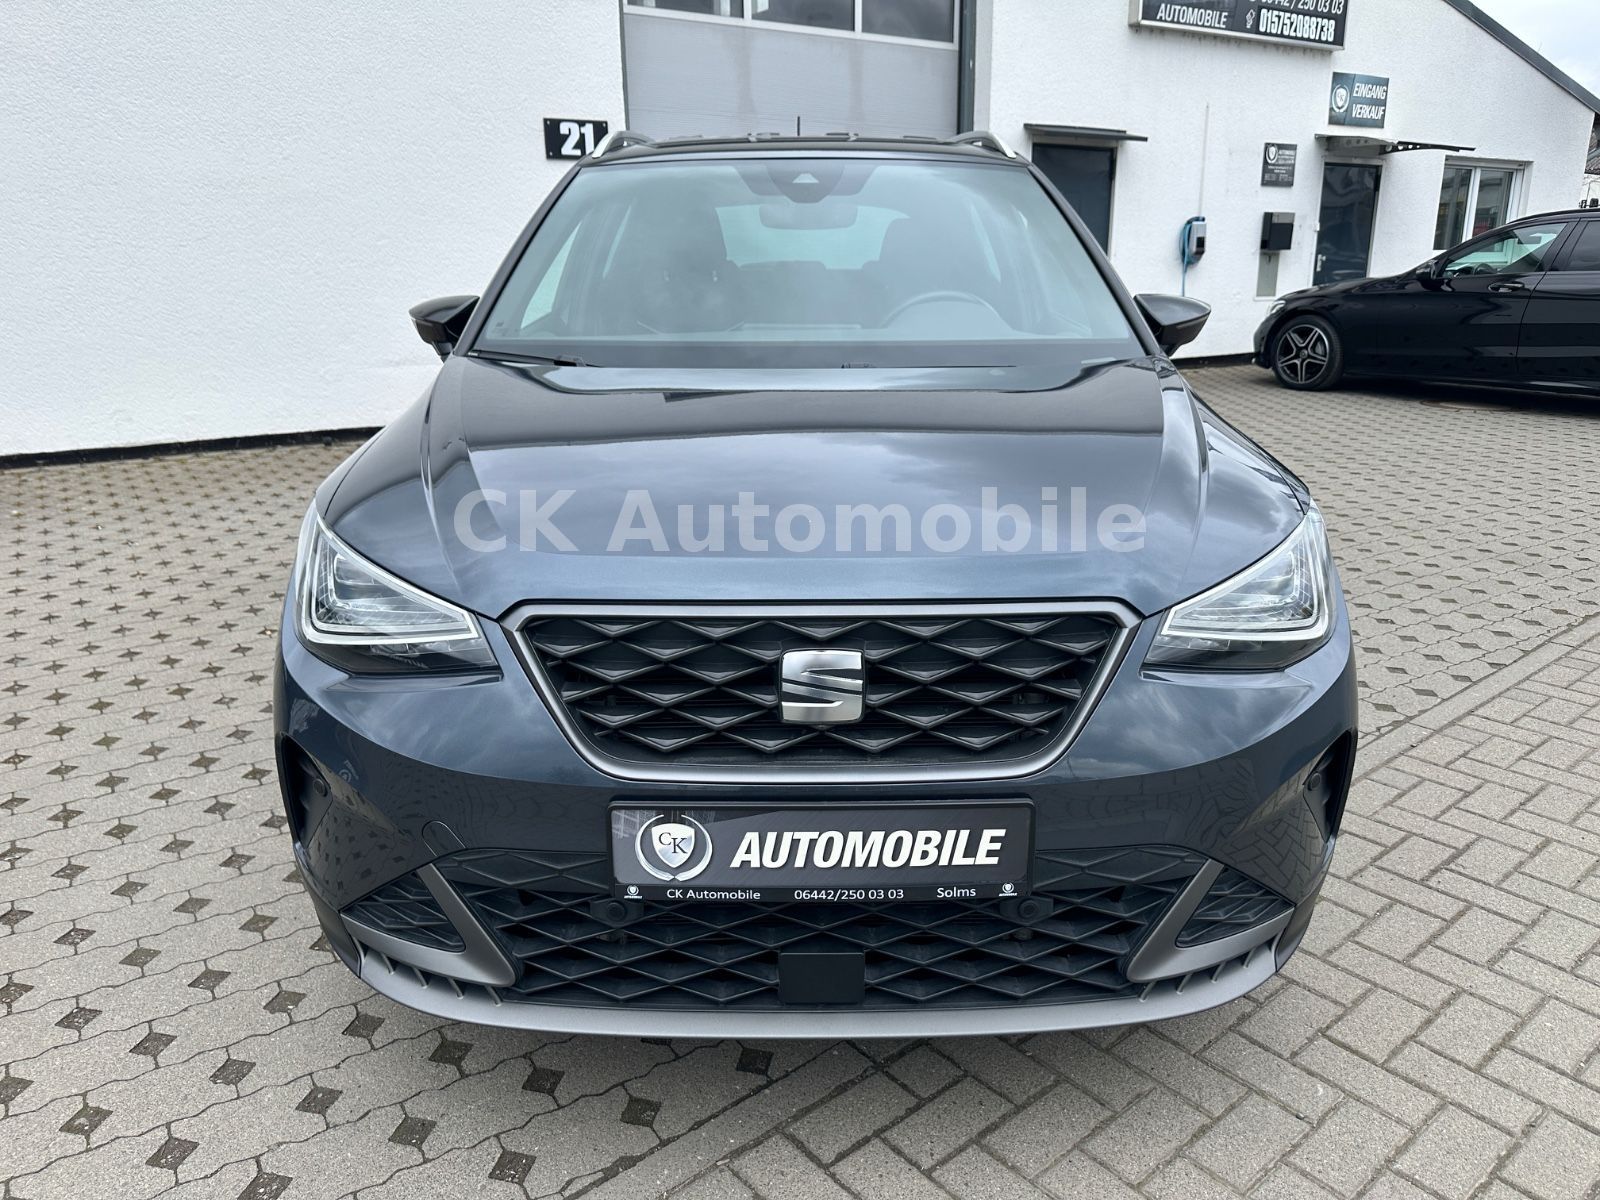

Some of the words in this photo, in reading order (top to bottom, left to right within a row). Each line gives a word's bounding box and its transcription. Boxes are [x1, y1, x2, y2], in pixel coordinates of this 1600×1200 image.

[1156, 3, 1228, 28] AUTOMOBILE
[1317, 0, 1330, 13] 03
[1331, 0, 1345, 14] 03
[1259, 8, 1335, 42] 015752088738
[1352, 83, 1387, 100] EINGANG
[1352, 104, 1385, 120] VERKAUF
[559, 121, 595, 156] 21
[658, 832, 688, 854] CK
[729, 829, 1007, 869] AUTOMOBILE
[666, 889, 684, 899] CK
[686, 889, 761, 900] Automobile
[794, 889, 865, 901] 06442/250
[868, 889, 884, 900] 03
[887, 889, 904, 899] 03
[936, 886, 977, 898] Solms
